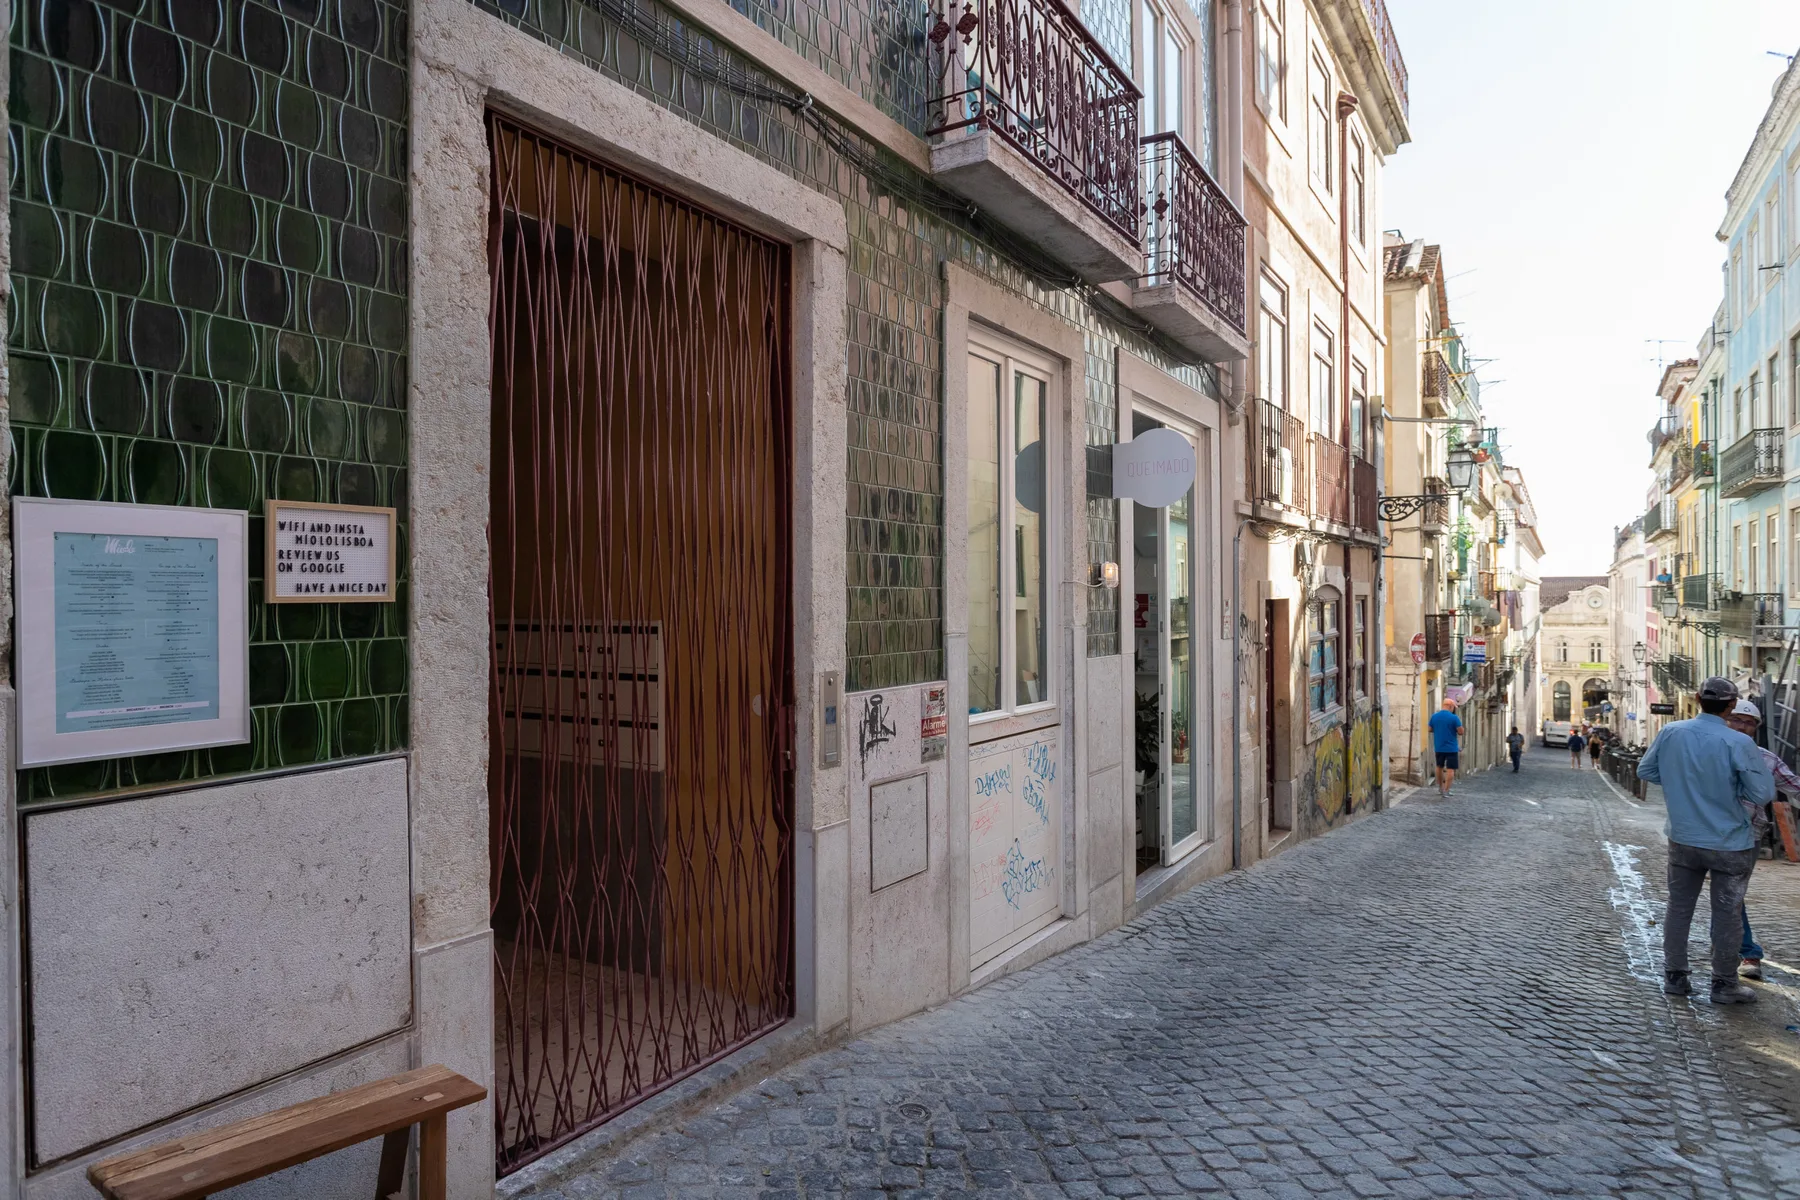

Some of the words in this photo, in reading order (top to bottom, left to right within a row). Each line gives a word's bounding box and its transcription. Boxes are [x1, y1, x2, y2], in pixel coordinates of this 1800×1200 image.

[1127, 458, 1189, 477] QUEIMADO
[278, 521, 305, 532] WIFI
[310, 523, 331, 533] AND
[335, 524, 364, 534] INSTA
[278, 549, 322, 561] REVIEW
[326, 551, 340, 561] US
[278, 562, 293, 573] ON
[300, 563, 345, 573] GOOGLE
[296, 583, 325, 593] HAVE
[329, 583, 336, 593] A
[339, 583, 364, 593] NICE
[367, 583, 387, 593] DAY
[923, 720, 946, 732] Alarme
